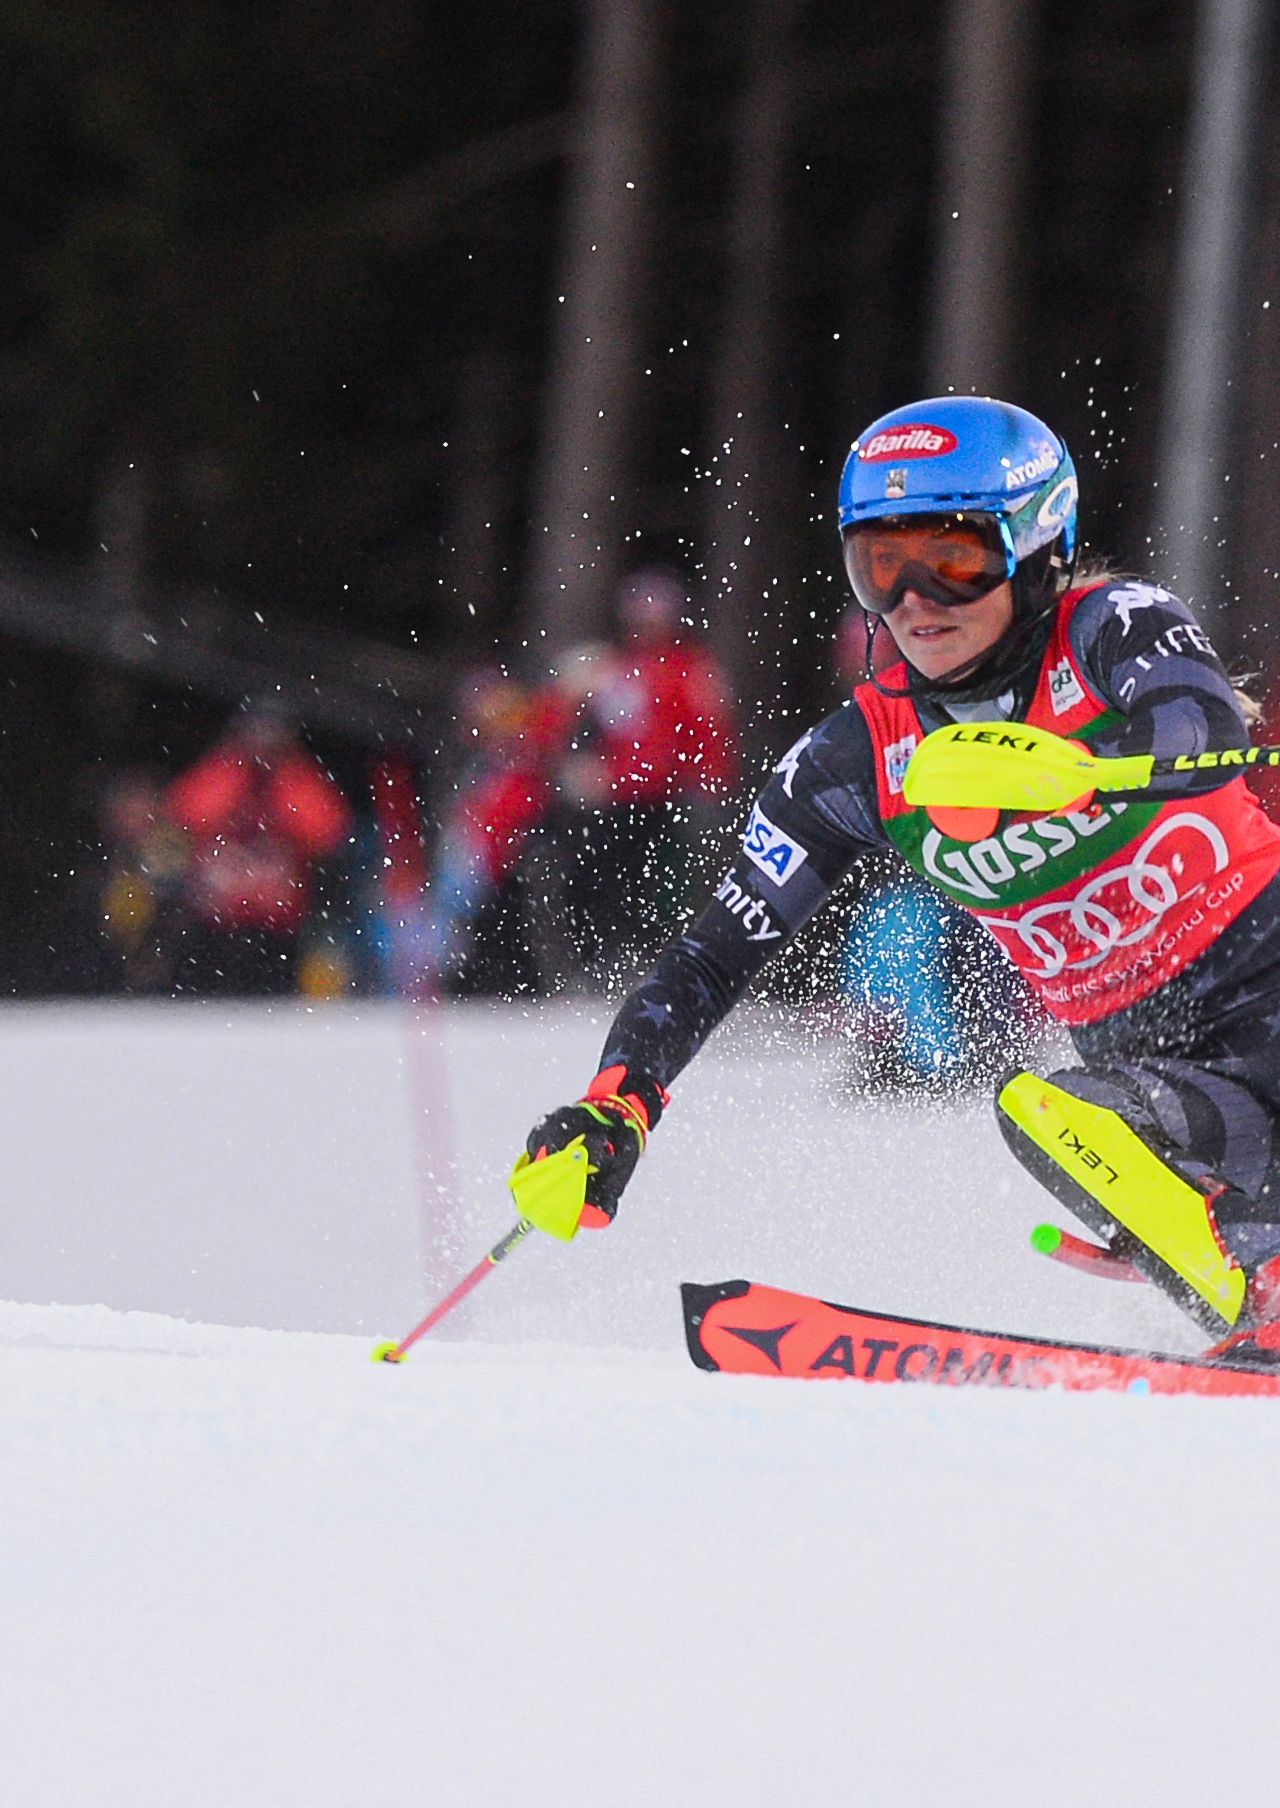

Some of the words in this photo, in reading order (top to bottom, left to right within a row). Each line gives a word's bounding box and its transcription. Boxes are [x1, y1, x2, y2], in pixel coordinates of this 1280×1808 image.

[866, 429, 945, 459] Barilla
[951, 730, 1038, 752] LEKI
[1058, 1128, 1118, 1184] LEKI
